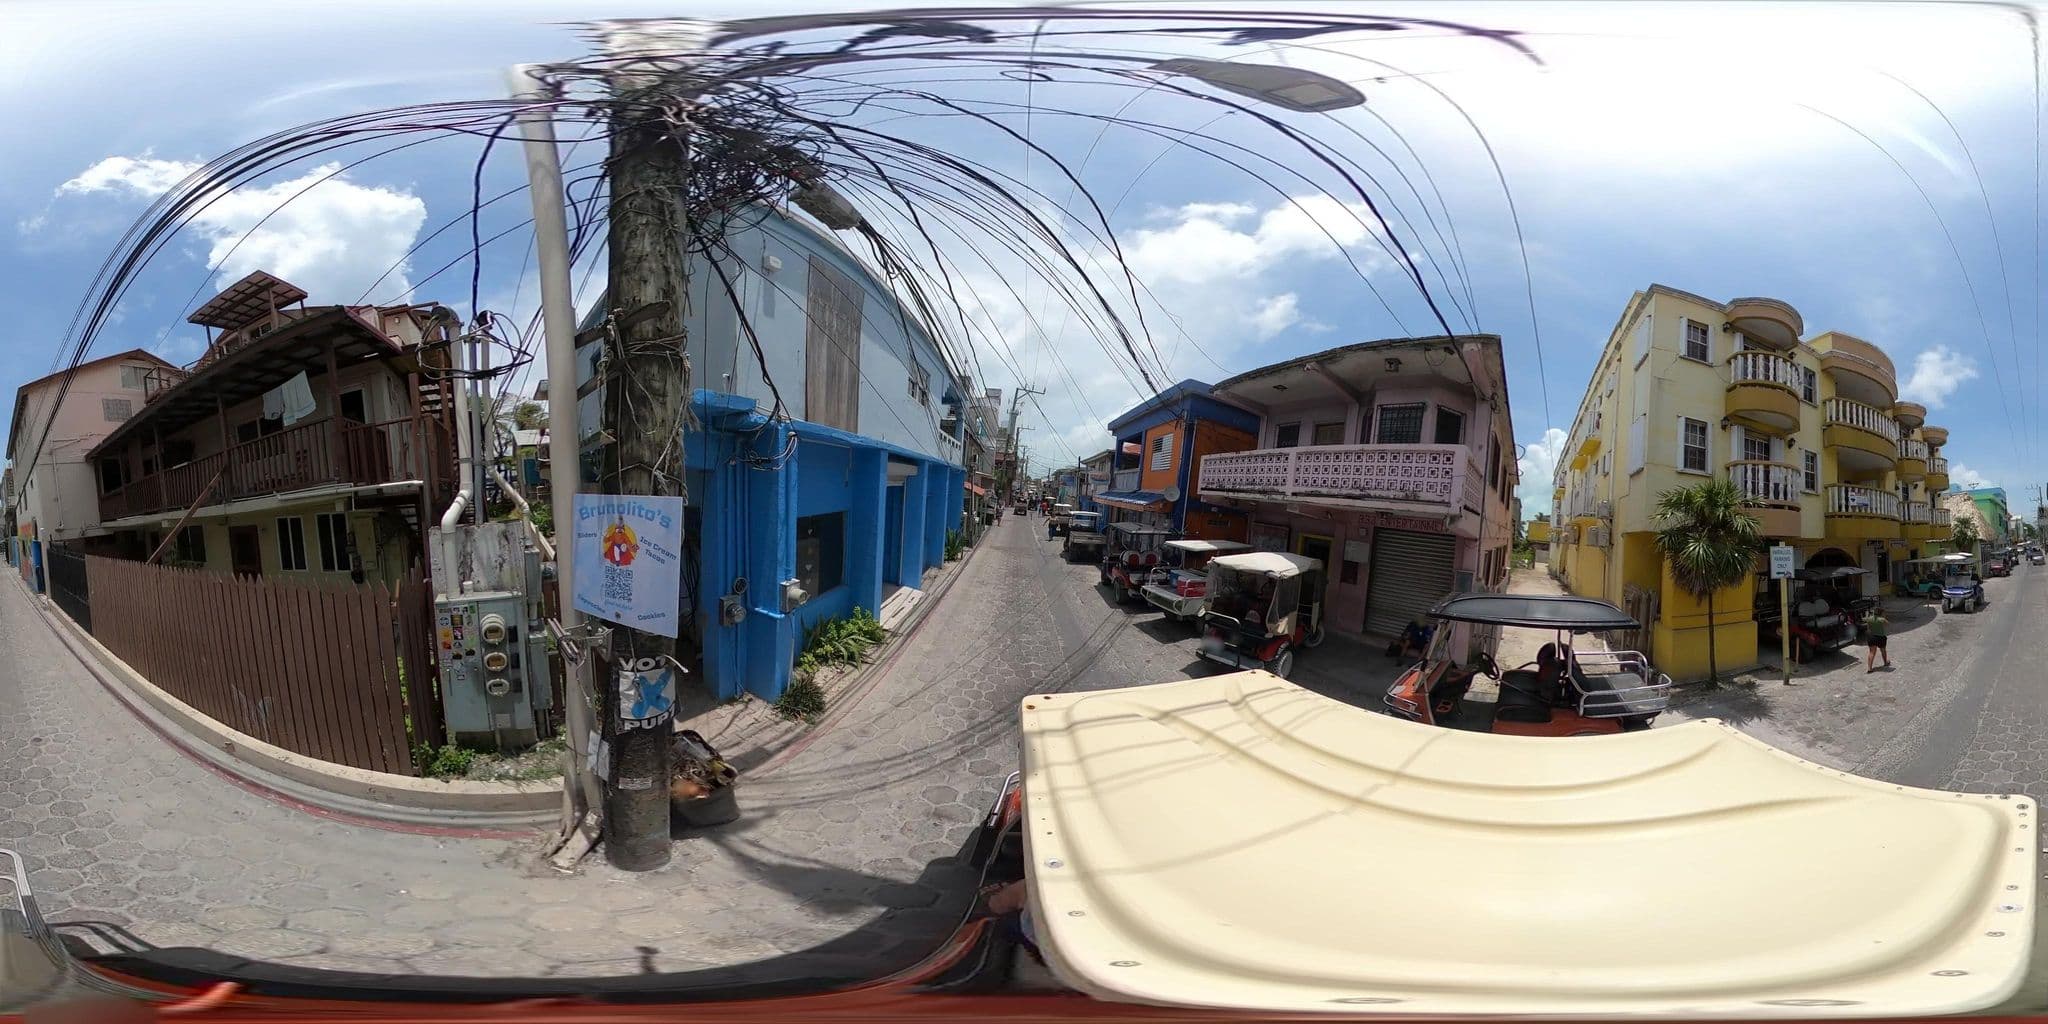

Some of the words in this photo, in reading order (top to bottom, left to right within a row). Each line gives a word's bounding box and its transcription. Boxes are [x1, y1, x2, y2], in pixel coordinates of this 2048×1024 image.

[579, 501, 672, 529] Brunolito's
[653, 543, 677, 561] Cream
[637, 611, 666, 621] Cookies
